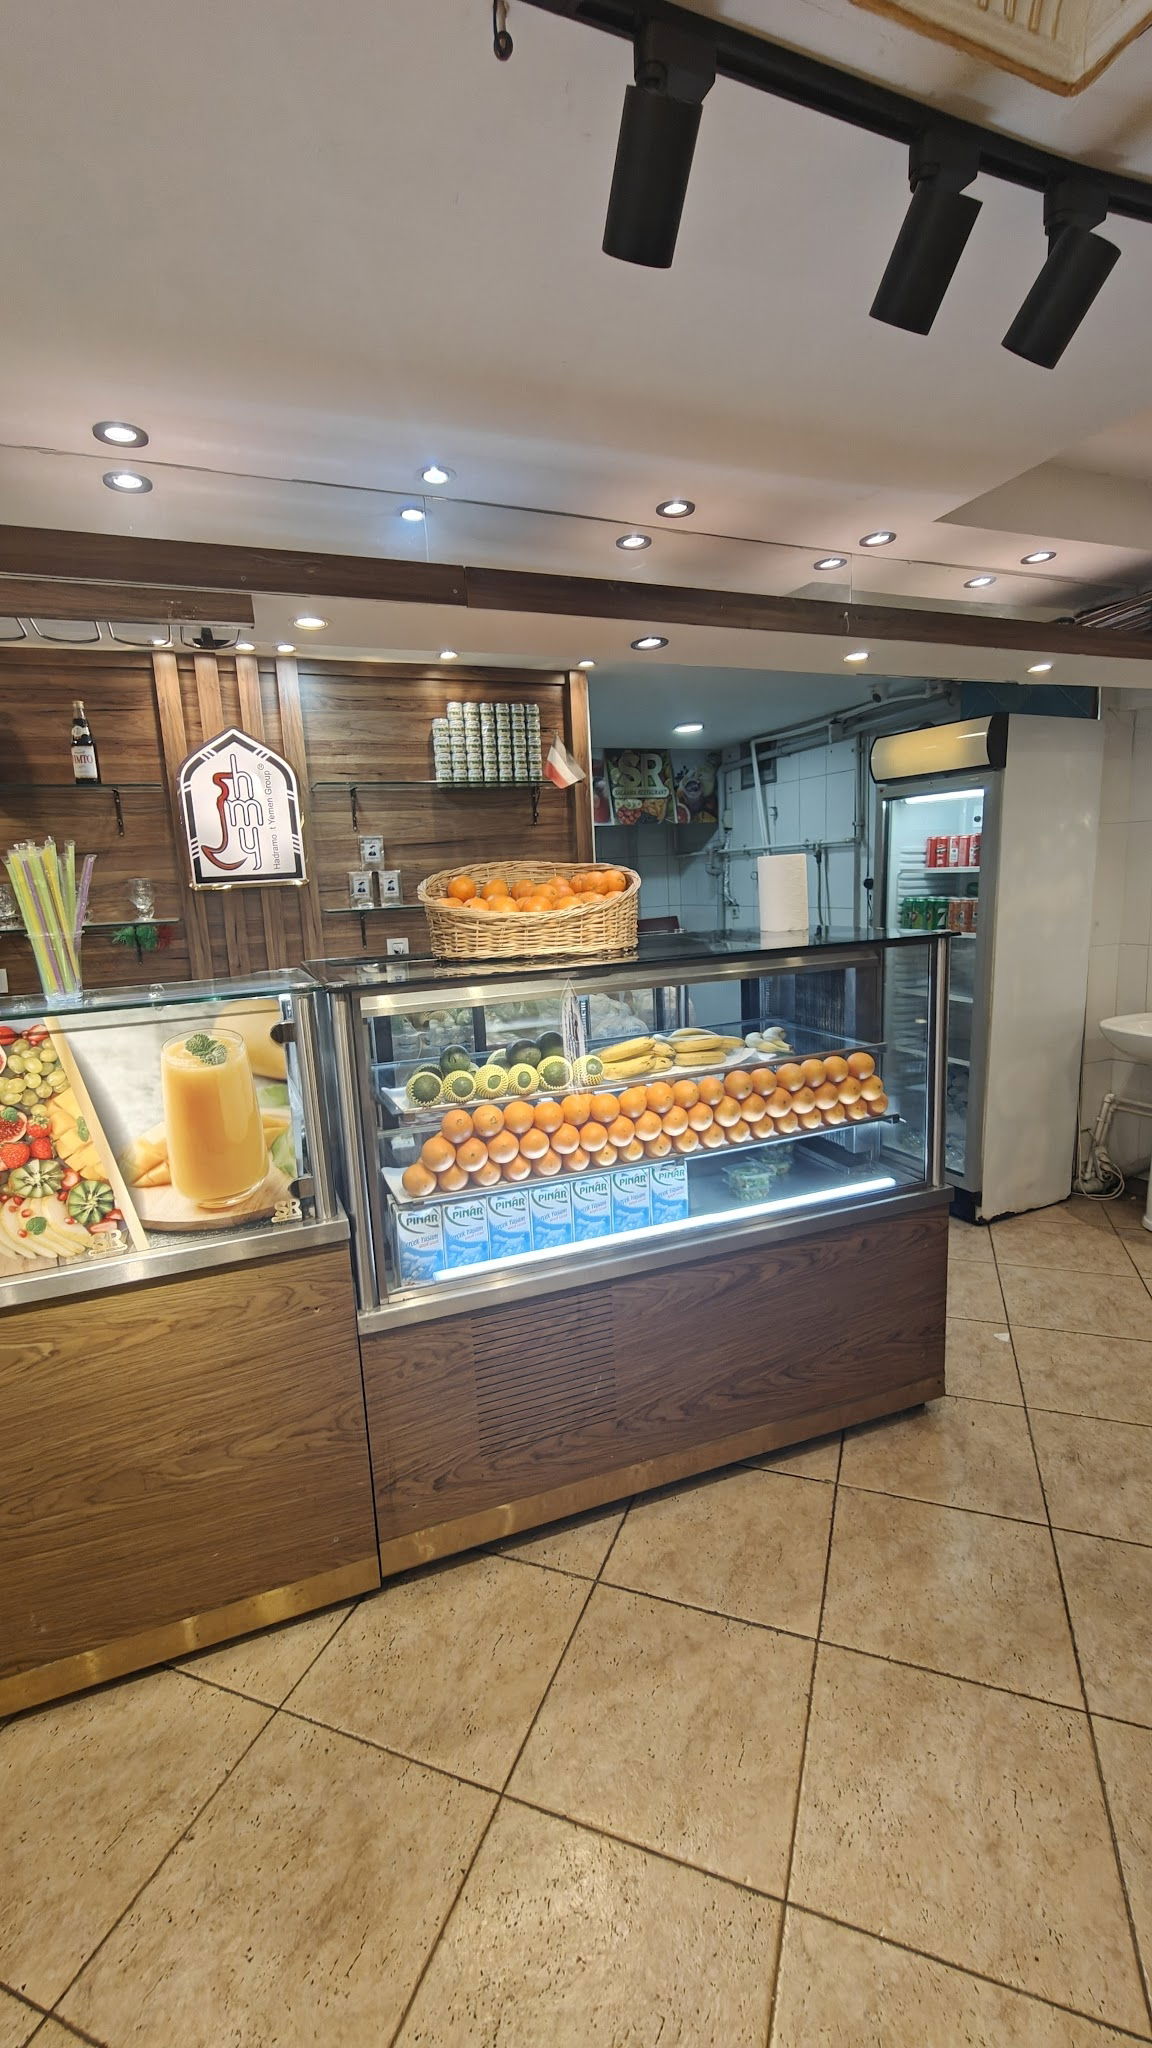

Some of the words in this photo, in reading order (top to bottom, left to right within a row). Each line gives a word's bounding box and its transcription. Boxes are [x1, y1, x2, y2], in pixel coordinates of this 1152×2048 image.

[618, 750, 664, 787] SR
[264, 770, 273, 795] Group
[267, 797, 276, 827] Yemen
[274, 1198, 302, 1217] SR
